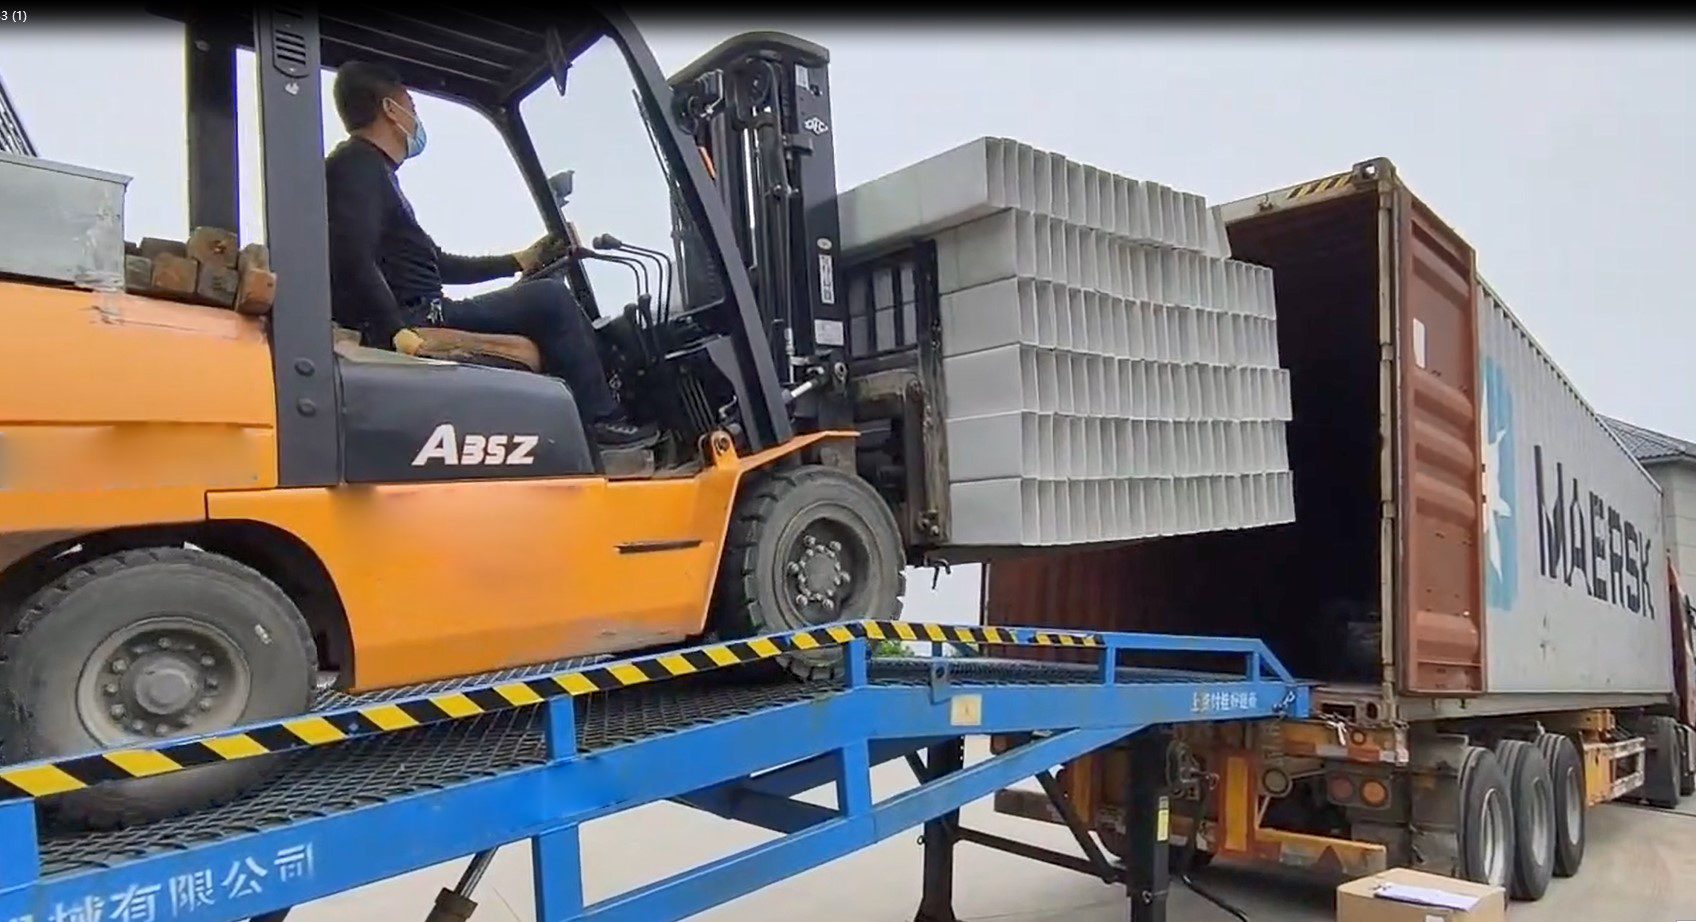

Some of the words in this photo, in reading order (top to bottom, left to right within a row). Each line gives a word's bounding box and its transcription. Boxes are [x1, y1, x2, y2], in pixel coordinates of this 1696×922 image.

[1534, 445, 1655, 620] MAERSK
[8, 841, 315, 922] 械有限公司
